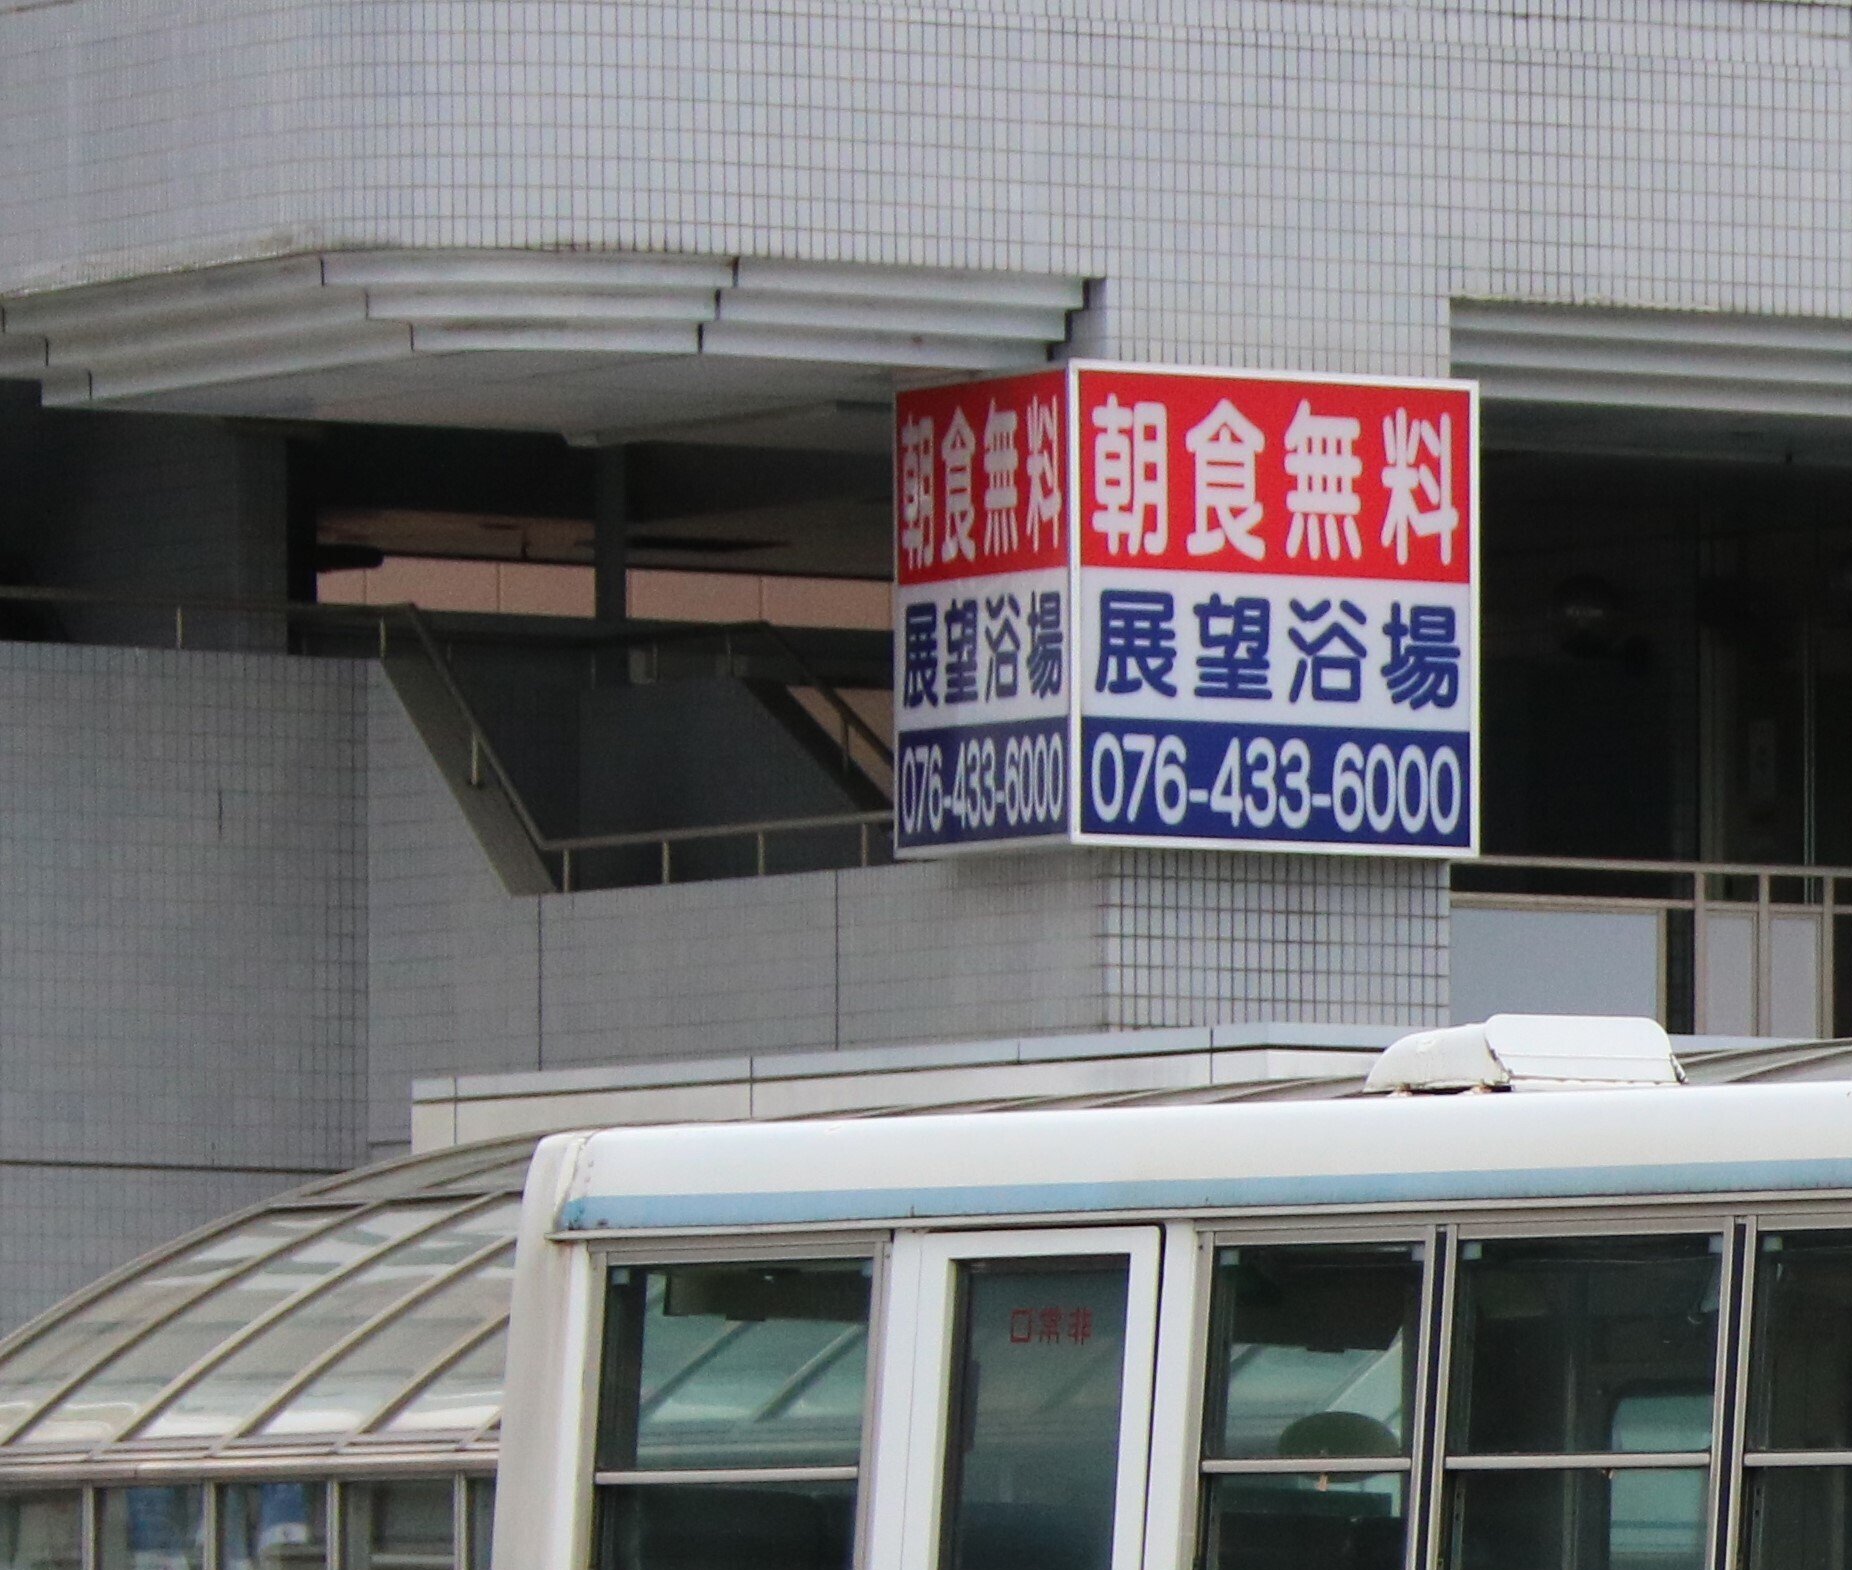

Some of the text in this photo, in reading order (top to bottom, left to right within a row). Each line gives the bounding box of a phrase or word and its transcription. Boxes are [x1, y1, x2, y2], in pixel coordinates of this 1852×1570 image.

[900, 393, 1062, 569] 朝食無料
[1091, 393, 1460, 566] 朝食無料
[903, 589, 1064, 708] 展望浴場
[1095, 589, 1462, 711] 展望浴場
[901, 731, 1063, 834] 076-433-6000
[1090, 732, 1462, 835] 076-433-6000
